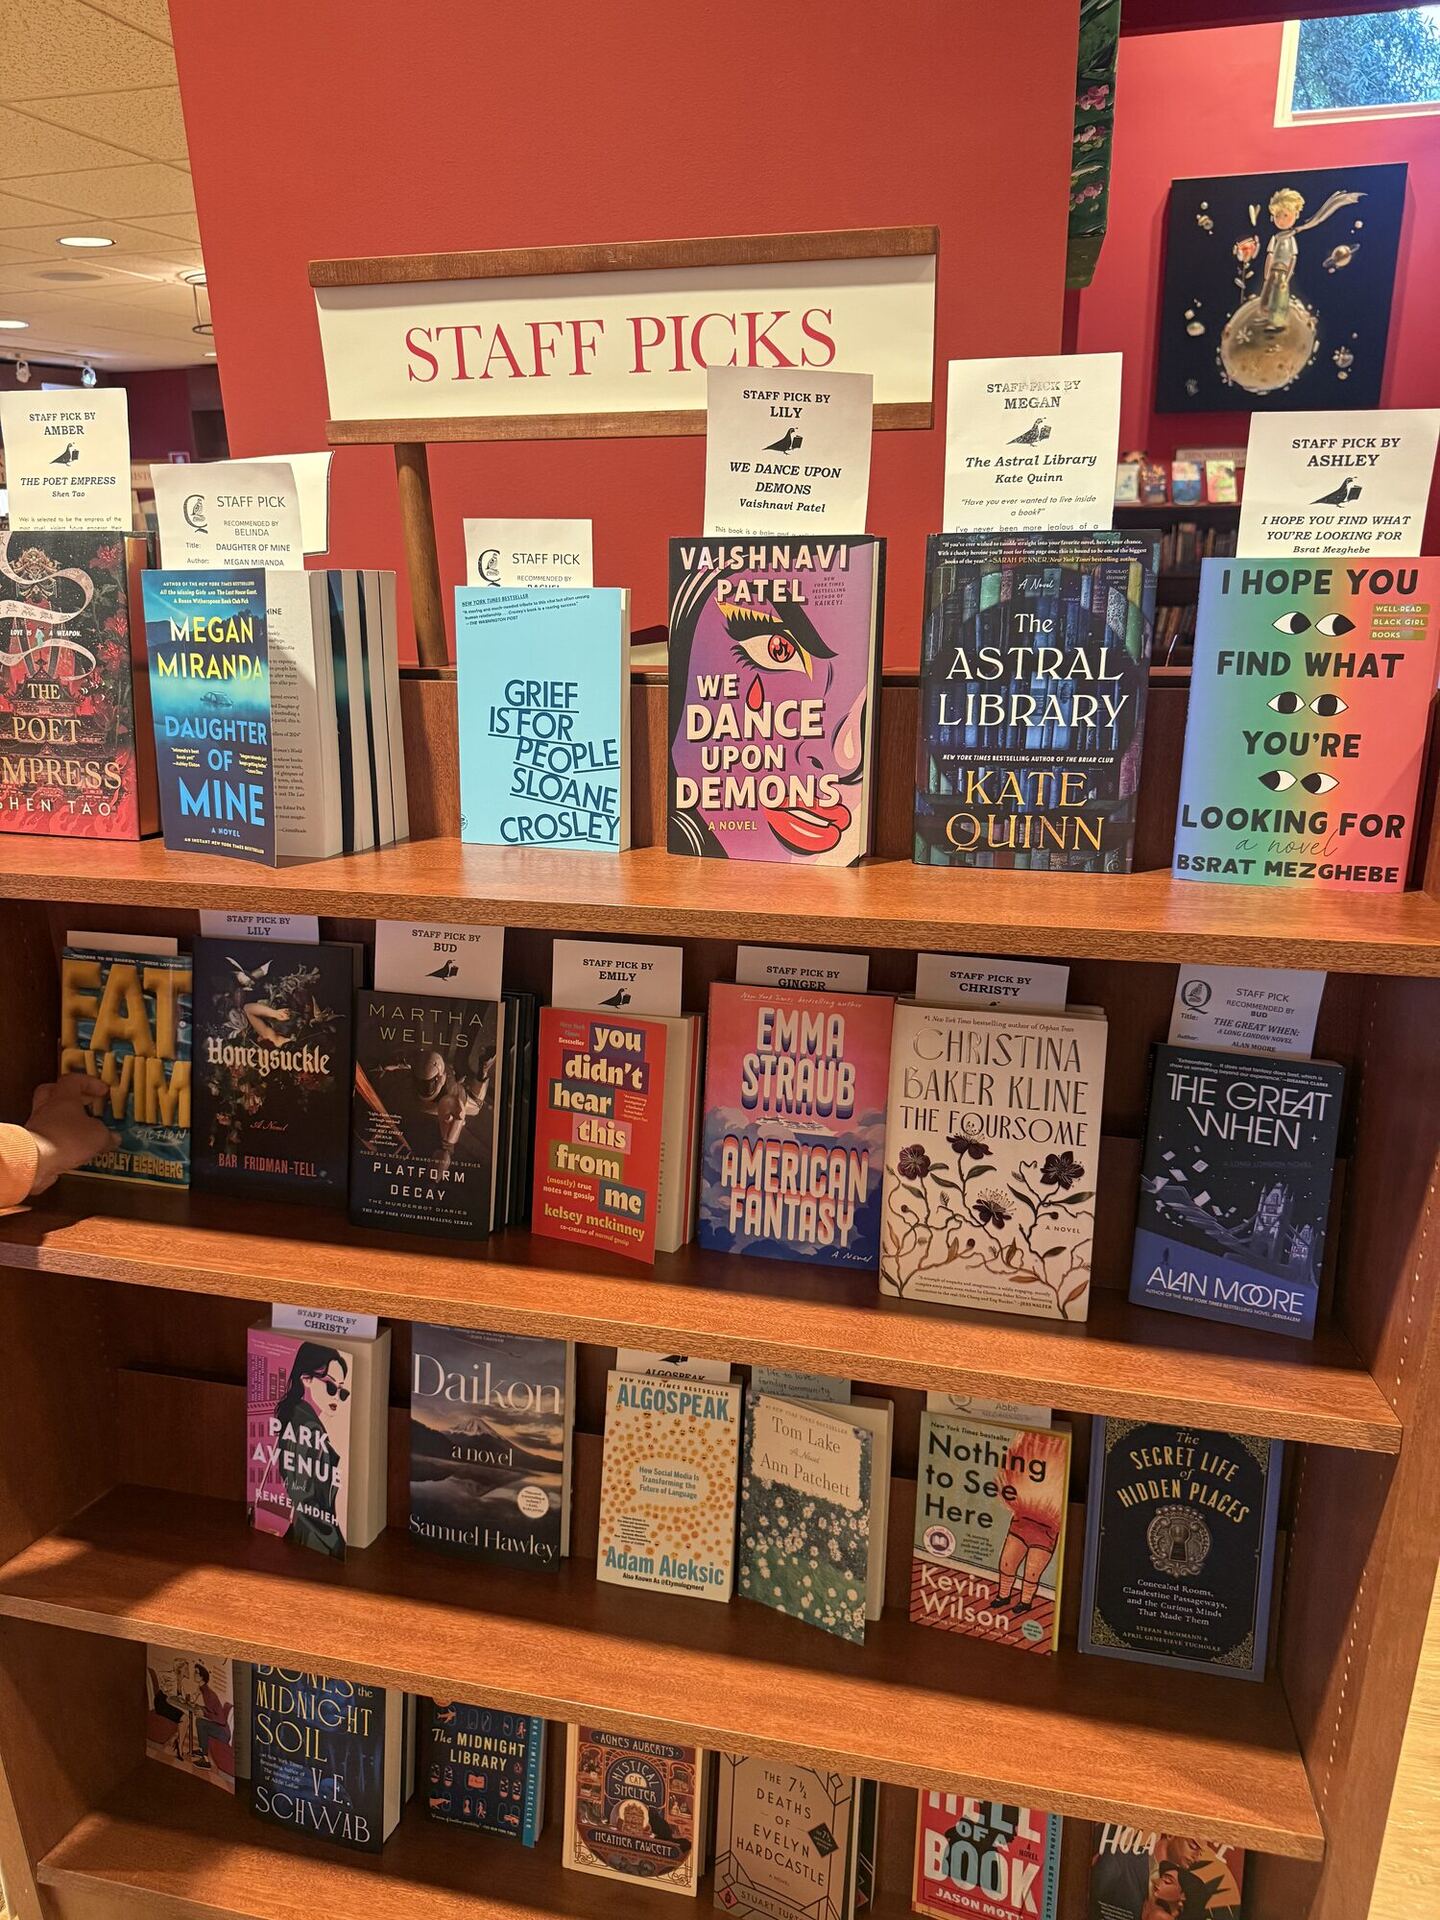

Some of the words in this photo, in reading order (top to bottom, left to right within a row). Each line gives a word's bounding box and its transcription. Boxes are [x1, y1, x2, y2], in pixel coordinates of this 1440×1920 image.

[405, 319, 604, 384] STAFF
[626, 308, 837, 374] PICKS
[743, 390, 780, 400] STAFF
[783, 392, 811, 402] PICK
[815, 394, 830, 403] BY
[1004, 396, 1061, 409] MEGAN
[29, 413, 57, 422] STAFF
[60, 412, 82, 421] PICK
[85, 412, 96, 421] BY
[770, 407, 802, 418] LILY
[44, 425, 84, 435] AMBER
[1292, 439, 1337, 448] STAFF
[1342, 439, 1376, 448] PICK
[1381, 438, 1400, 447] BY
[730, 462, 750, 472] WE
[755, 464, 799, 475] DANCE
[804, 467, 841, 478] UPON
[966, 457, 990, 468] The
[995, 455, 1039, 467] Astral
[1043, 455, 1097, 466] Library
[1307, 454, 1380, 467] ASHLEY
[21, 477, 40, 486] THE
[43, 477, 68, 485] POET
[71, 476, 116, 485] EMPRESS
[755, 482, 811, 495] DEMONS
[995, 475, 1023, 483] Kate
[1027, 474, 1063, 483] Quinn
[217, 496, 253, 508] STAFF
[258, 496, 286, 508] PICK
[740, 499, 793, 510] Vaishnavi
[797, 502, 825, 512] Patel
[235, 529, 269, 537] BELINDA
[680, 545, 848, 570] VAISHNAVI
[1323, 546, 1370, 554] Mezghebe
[717, 579, 806, 603] PATEL
[1222, 570, 1230, 595] I
[1241, 569, 1333, 595] HOPE
[1347, 569, 1418, 595] YOU
[170, 616, 254, 644] MEGAN
[1015, 614, 1053, 633] The
[158, 652, 264, 681] MIRANDA
[946, 647, 1124, 680] ASTRAL
[1217, 651, 1291, 676] FIND
[1305, 652, 1404, 679] WHAT
[28, 684, 61, 700] THE
[505, 680, 578, 708] GRIEF
[697, 674, 737, 698] WE
[490, 707, 510, 733] IS
[517, 710, 573, 741] FOR
[687, 700, 823, 740] DANCE
[938, 694, 1129, 727] LIBRARY
[12, 717, 81, 743] POET
[165, 716, 267, 745] DAUGHTER
[1242, 731, 1361, 758] YOU'RE
[208, 749, 233, 772] OF
[516, 737, 618, 773] PEOPLE
[702, 745, 784, 771] UPON
[179, 777, 265, 826] MINE
[512, 768, 618, 814] SLOANE
[676, 774, 840, 809] DEMONS
[965, 770, 1088, 806] KATE
[500, 811, 620, 842] CROSLEY
[946, 813, 1104, 851] QUINN
[1181, 805, 1328, 835] LOOKING
[1339, 813, 1405, 838] FOR
[1177, 854, 1256, 875] BSRAT
[1264, 861, 1398, 883] MEZGHEBE
[583, 959, 612, 967] STAFF
[616, 961, 638, 969] PICK
[600, 971, 636, 981] EMILY
[950, 971, 984, 981] STAFF
[988, 975, 1014, 983] PICK
[1017, 976, 1032, 984] BY
[960, 983, 1020, 996] CHRISTY
[61, 959, 192, 1059] EAT
[369, 1004, 483, 1027] MARTHA
[380, 1027, 469, 1048] WELLS
[594, 1027, 641, 1052] you
[757, 1007, 845, 1066] EMMA
[913, 1027, 1081, 1072] CHRISTINA
[207, 1036, 330, 1076] Honeysuckle
[565, 1054, 642, 1090] didn't
[742, 1053, 856, 1117] STRAUB
[554, 1083, 612, 1114] hear
[904, 1065, 994, 1107] BAKER
[1008, 1075, 1089, 1115] KLINE
[1167, 1073, 1218, 1106] THE
[1226, 1082, 1333, 1121] GREAT
[578, 1120, 626, 1148] this
[900, 1105, 939, 1132] THE
[949, 1110, 1088, 1147] FOURSOME
[1187, 1106, 1301, 1150] WHEN
[219, 1153, 237, 1168] BAR
[244, 1154, 316, 1177] FRIDMAN-TELL
[373, 1162, 465, 1183] PLATFORM
[557, 1144, 620, 1180] from
[721, 1135, 869, 1203] AMERICAN
[391, 1184, 445, 1200] DECAY
[604, 1188, 642, 1215] me
[544, 1203, 583, 1225] kelsey
[586, 1214, 645, 1242] mckinney
[729, 1186, 854, 1247] FANTASY
[1147, 1266, 1207, 1297] ALAN
[1215, 1278, 1305, 1315] MOORE
[412, 1353, 560, 1415] Daikon
[617, 1384, 729, 1421] ALGOSPEAK
[269, 1417, 329, 1453] PARK
[772, 1415, 802, 1441] Tom
[808, 1428, 841, 1454] Lake
[253, 1443, 341, 1488] AVENUE
[928, 1431, 1046, 1482] Nothing
[1130, 1446, 1195, 1470] SECRET
[1201, 1451, 1240, 1482] LIFE
[760, 1453, 788, 1475] Ann
[794, 1463, 850, 1498] Patchett
[926, 1465, 953, 1488] to
[964, 1470, 1017, 1501] See
[256, 1488, 292, 1508] RENÉE
[296, 1502, 338, 1526] AHDIEH
[925, 1494, 993, 1528] Here
[1117, 1479, 1181, 1508] HIDDEN
[1189, 1482, 1250, 1524] PLACES
[409, 1513, 480, 1547] Samuel
[485, 1529, 558, 1563] Hawley
[606, 1546, 654, 1574] Adam
[659, 1555, 724, 1585] Aleksic
[921, 1564, 990, 1600] Kevin
[920, 1589, 1009, 1631] Wilson
[256, 1680, 372, 1736] MIDNIGHT
[256, 1712, 328, 1762] SOIL
[432, 1729, 451, 1744] The
[457, 1732, 525, 1757] MIDNIGHT
[450, 1749, 507, 1771] LIBRARY
[612, 1760, 659, 1786] MYSTICAL
[629, 1776, 642, 1784] CAT
[256, 1786, 370, 1843] SCHWAB
[757, 1788, 811, 1819] DEATHS
[776, 1815, 790, 1828] OF
[956, 1821, 988, 1841] OF
[993, 1833, 1009, 1852] A
[754, 1824, 809, 1858] EVELYN
[1099, 1823, 1157, 1856] HOLA
[737, 1837, 824, 1886] HARDCASTLE
[924, 1828, 1040, 1914] BOOK
